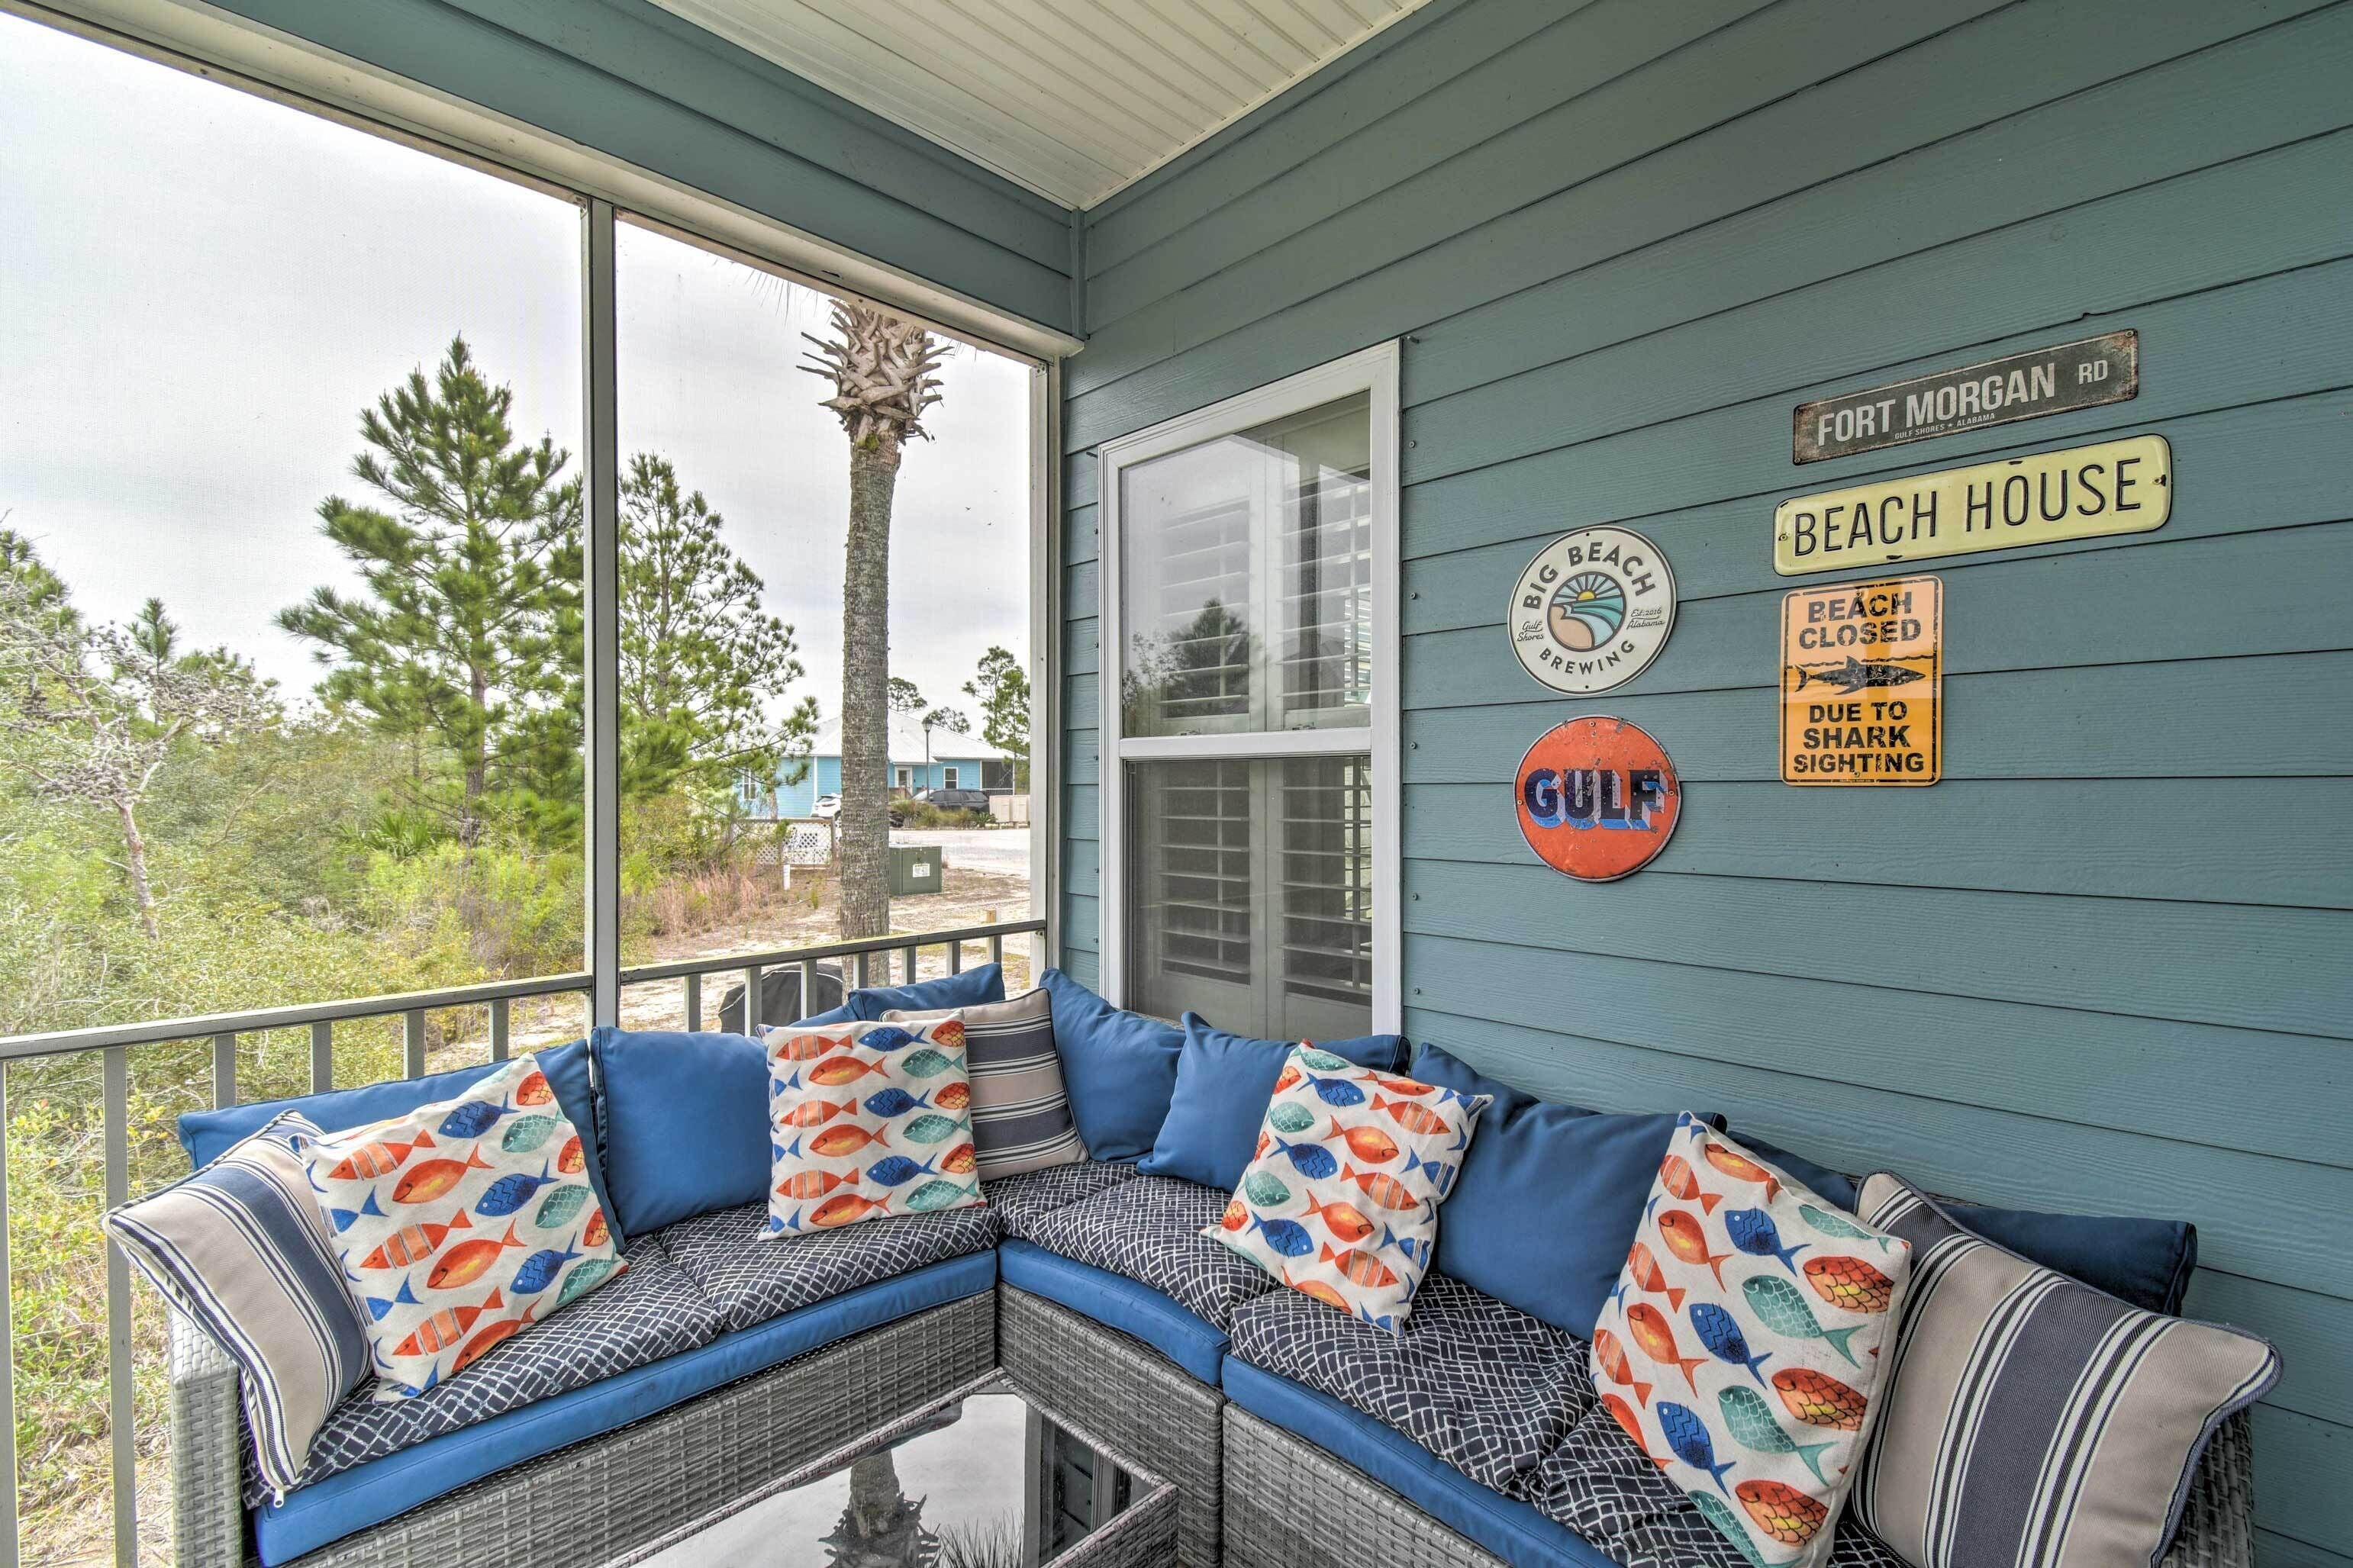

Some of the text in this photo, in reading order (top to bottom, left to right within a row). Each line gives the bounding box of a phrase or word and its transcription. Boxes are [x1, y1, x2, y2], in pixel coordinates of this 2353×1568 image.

[1817, 359, 2109, 447] FORT MORGAN RD
[1894, 413, 1996, 439] GULF SHORES ALABAMA
[1794, 458, 2142, 557] BEACH HOUSE
[1523, 542, 1656, 610] BIG BEACH
[1807, 591, 1913, 623] BEACH
[1517, 632, 1544, 642] Shores
[1522, 620, 1543, 633] Gulf
[1799, 618, 1921, 649] CLOSED
[1539, 640, 1635, 675] BREWING
[1809, 700, 1907, 723] DUE TO
[1803, 725, 1912, 750] SHARK
[1794, 752, 1924, 773] SIGHTING
[1524, 768, 1669, 831] GULF
